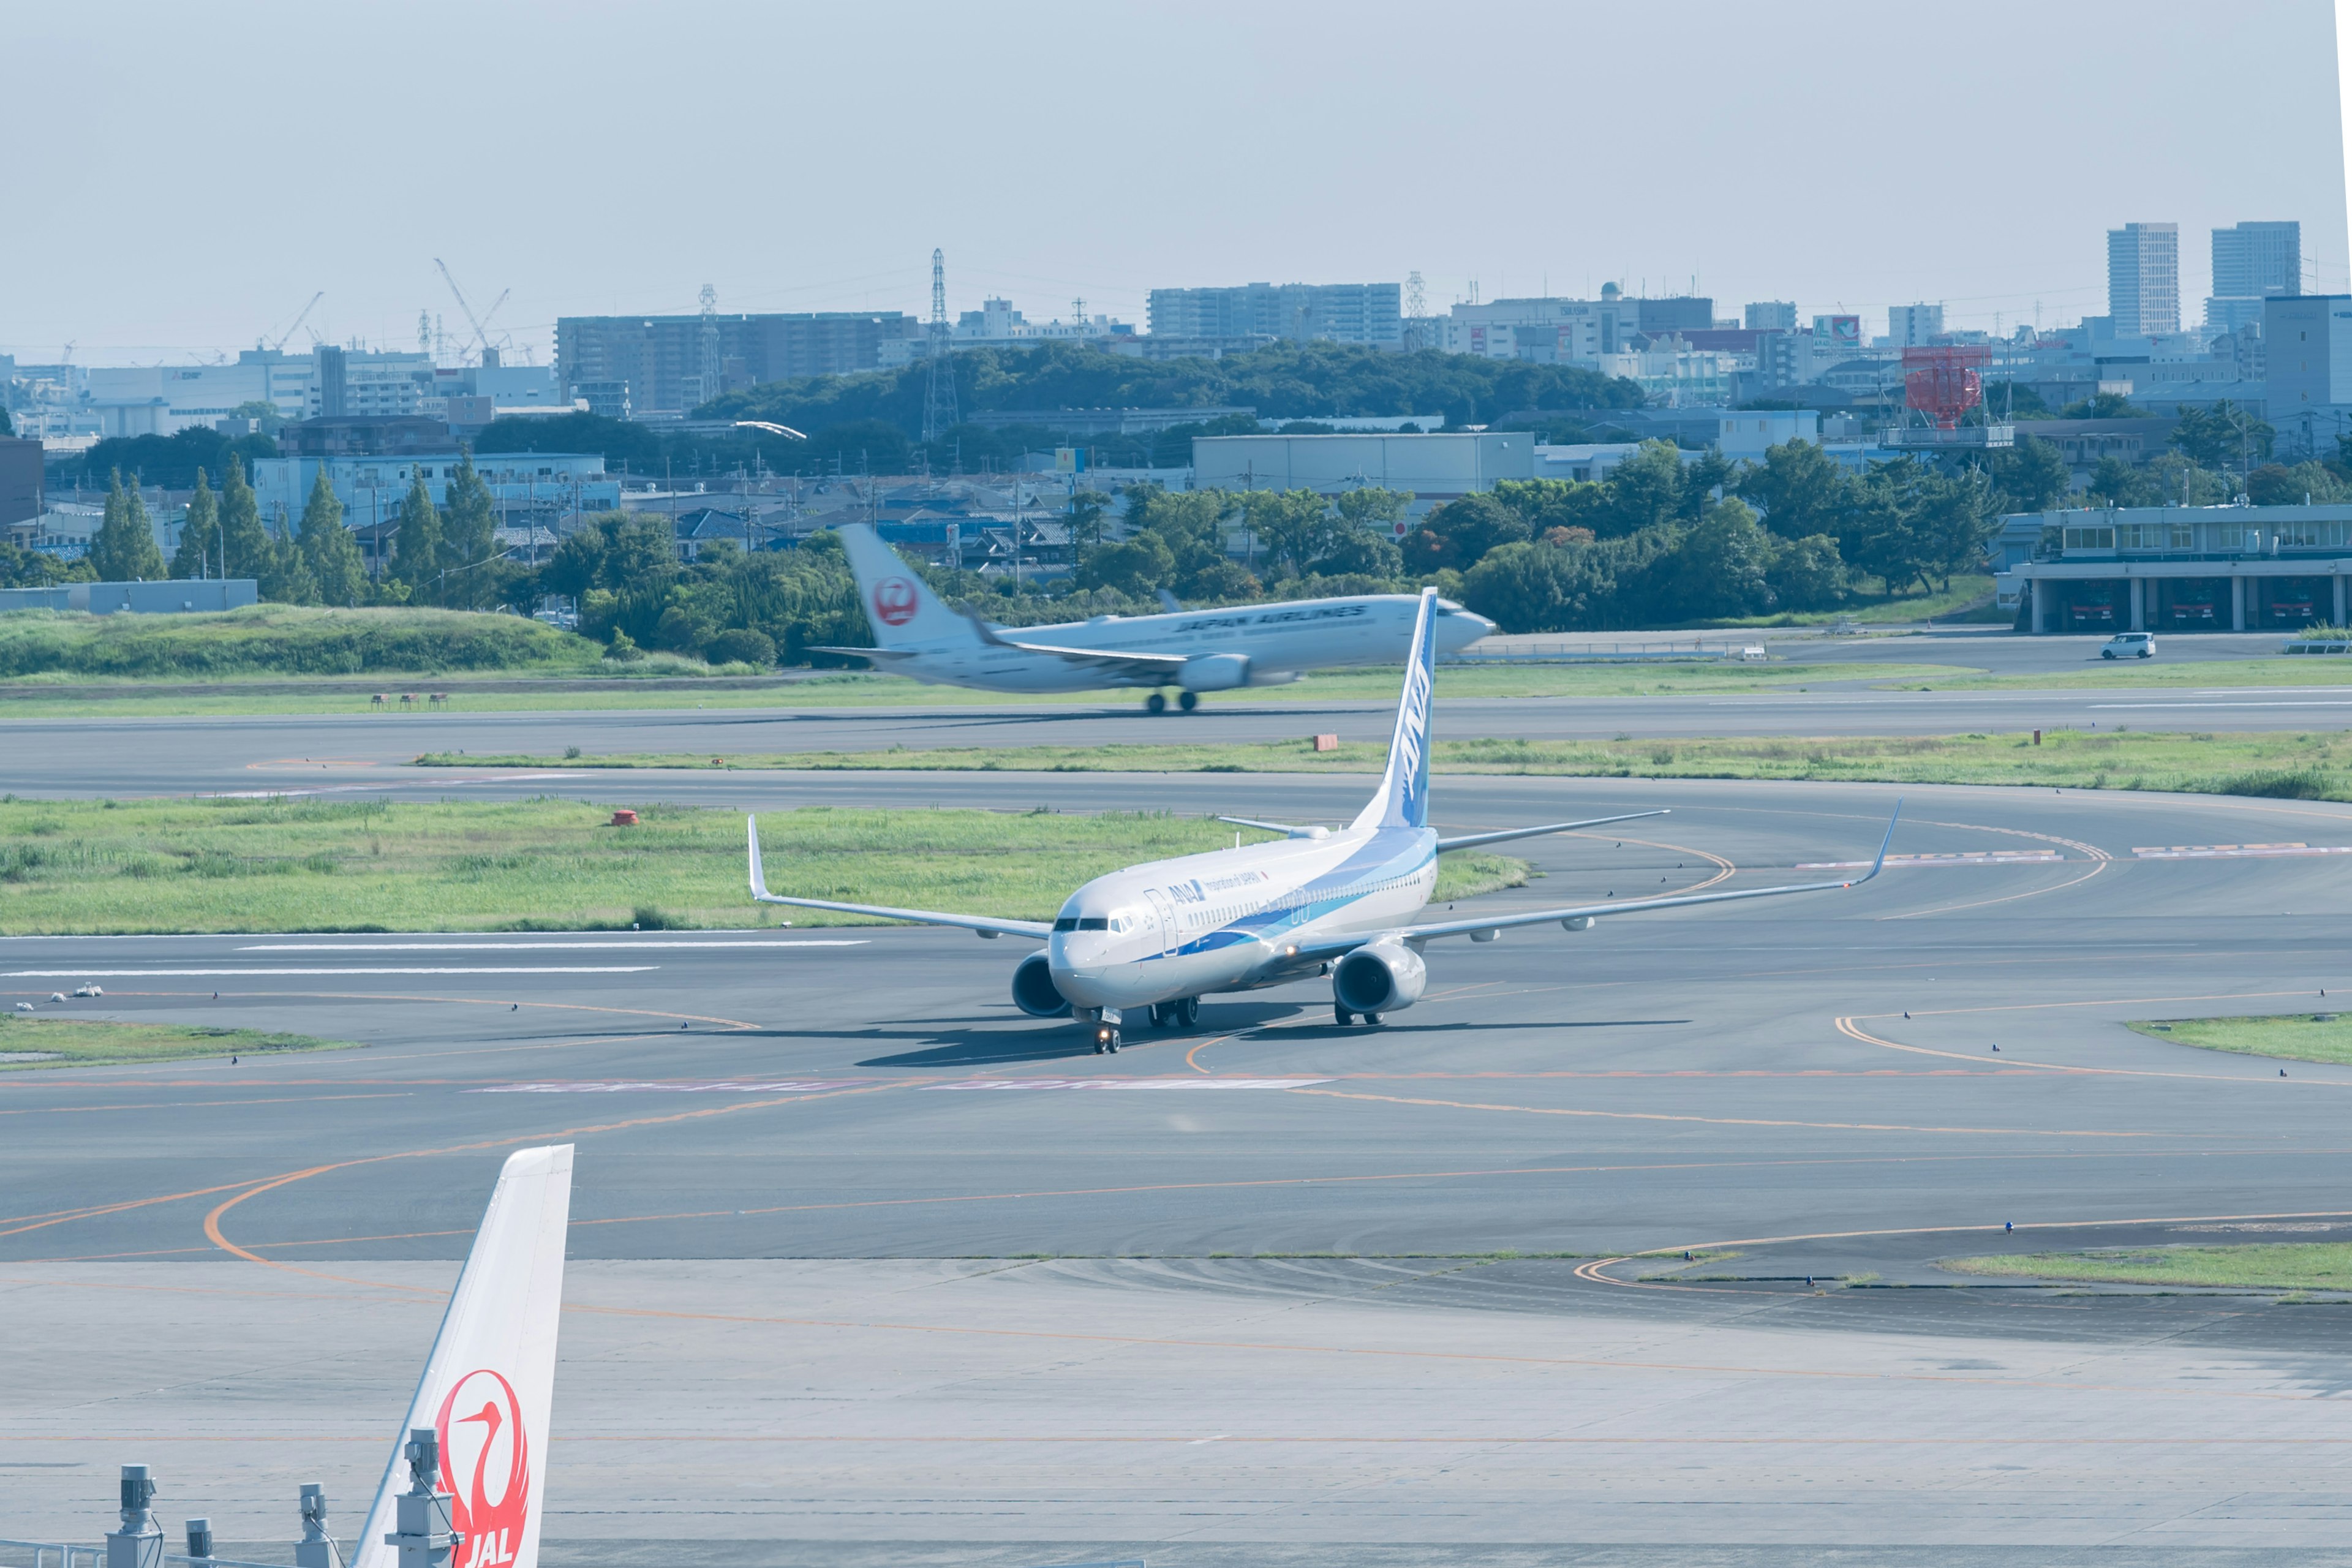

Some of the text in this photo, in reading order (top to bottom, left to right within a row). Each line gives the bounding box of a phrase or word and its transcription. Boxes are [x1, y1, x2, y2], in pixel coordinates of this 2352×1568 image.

[1172, 605, 1370, 633] JAPAN AIRLINES
[1400, 657, 1430, 801] ANA
[1168, 883, 1199, 905] ANA
[1238, 872, 1261, 884] JAPAN
[464, 1527, 513, 1568] JAL
